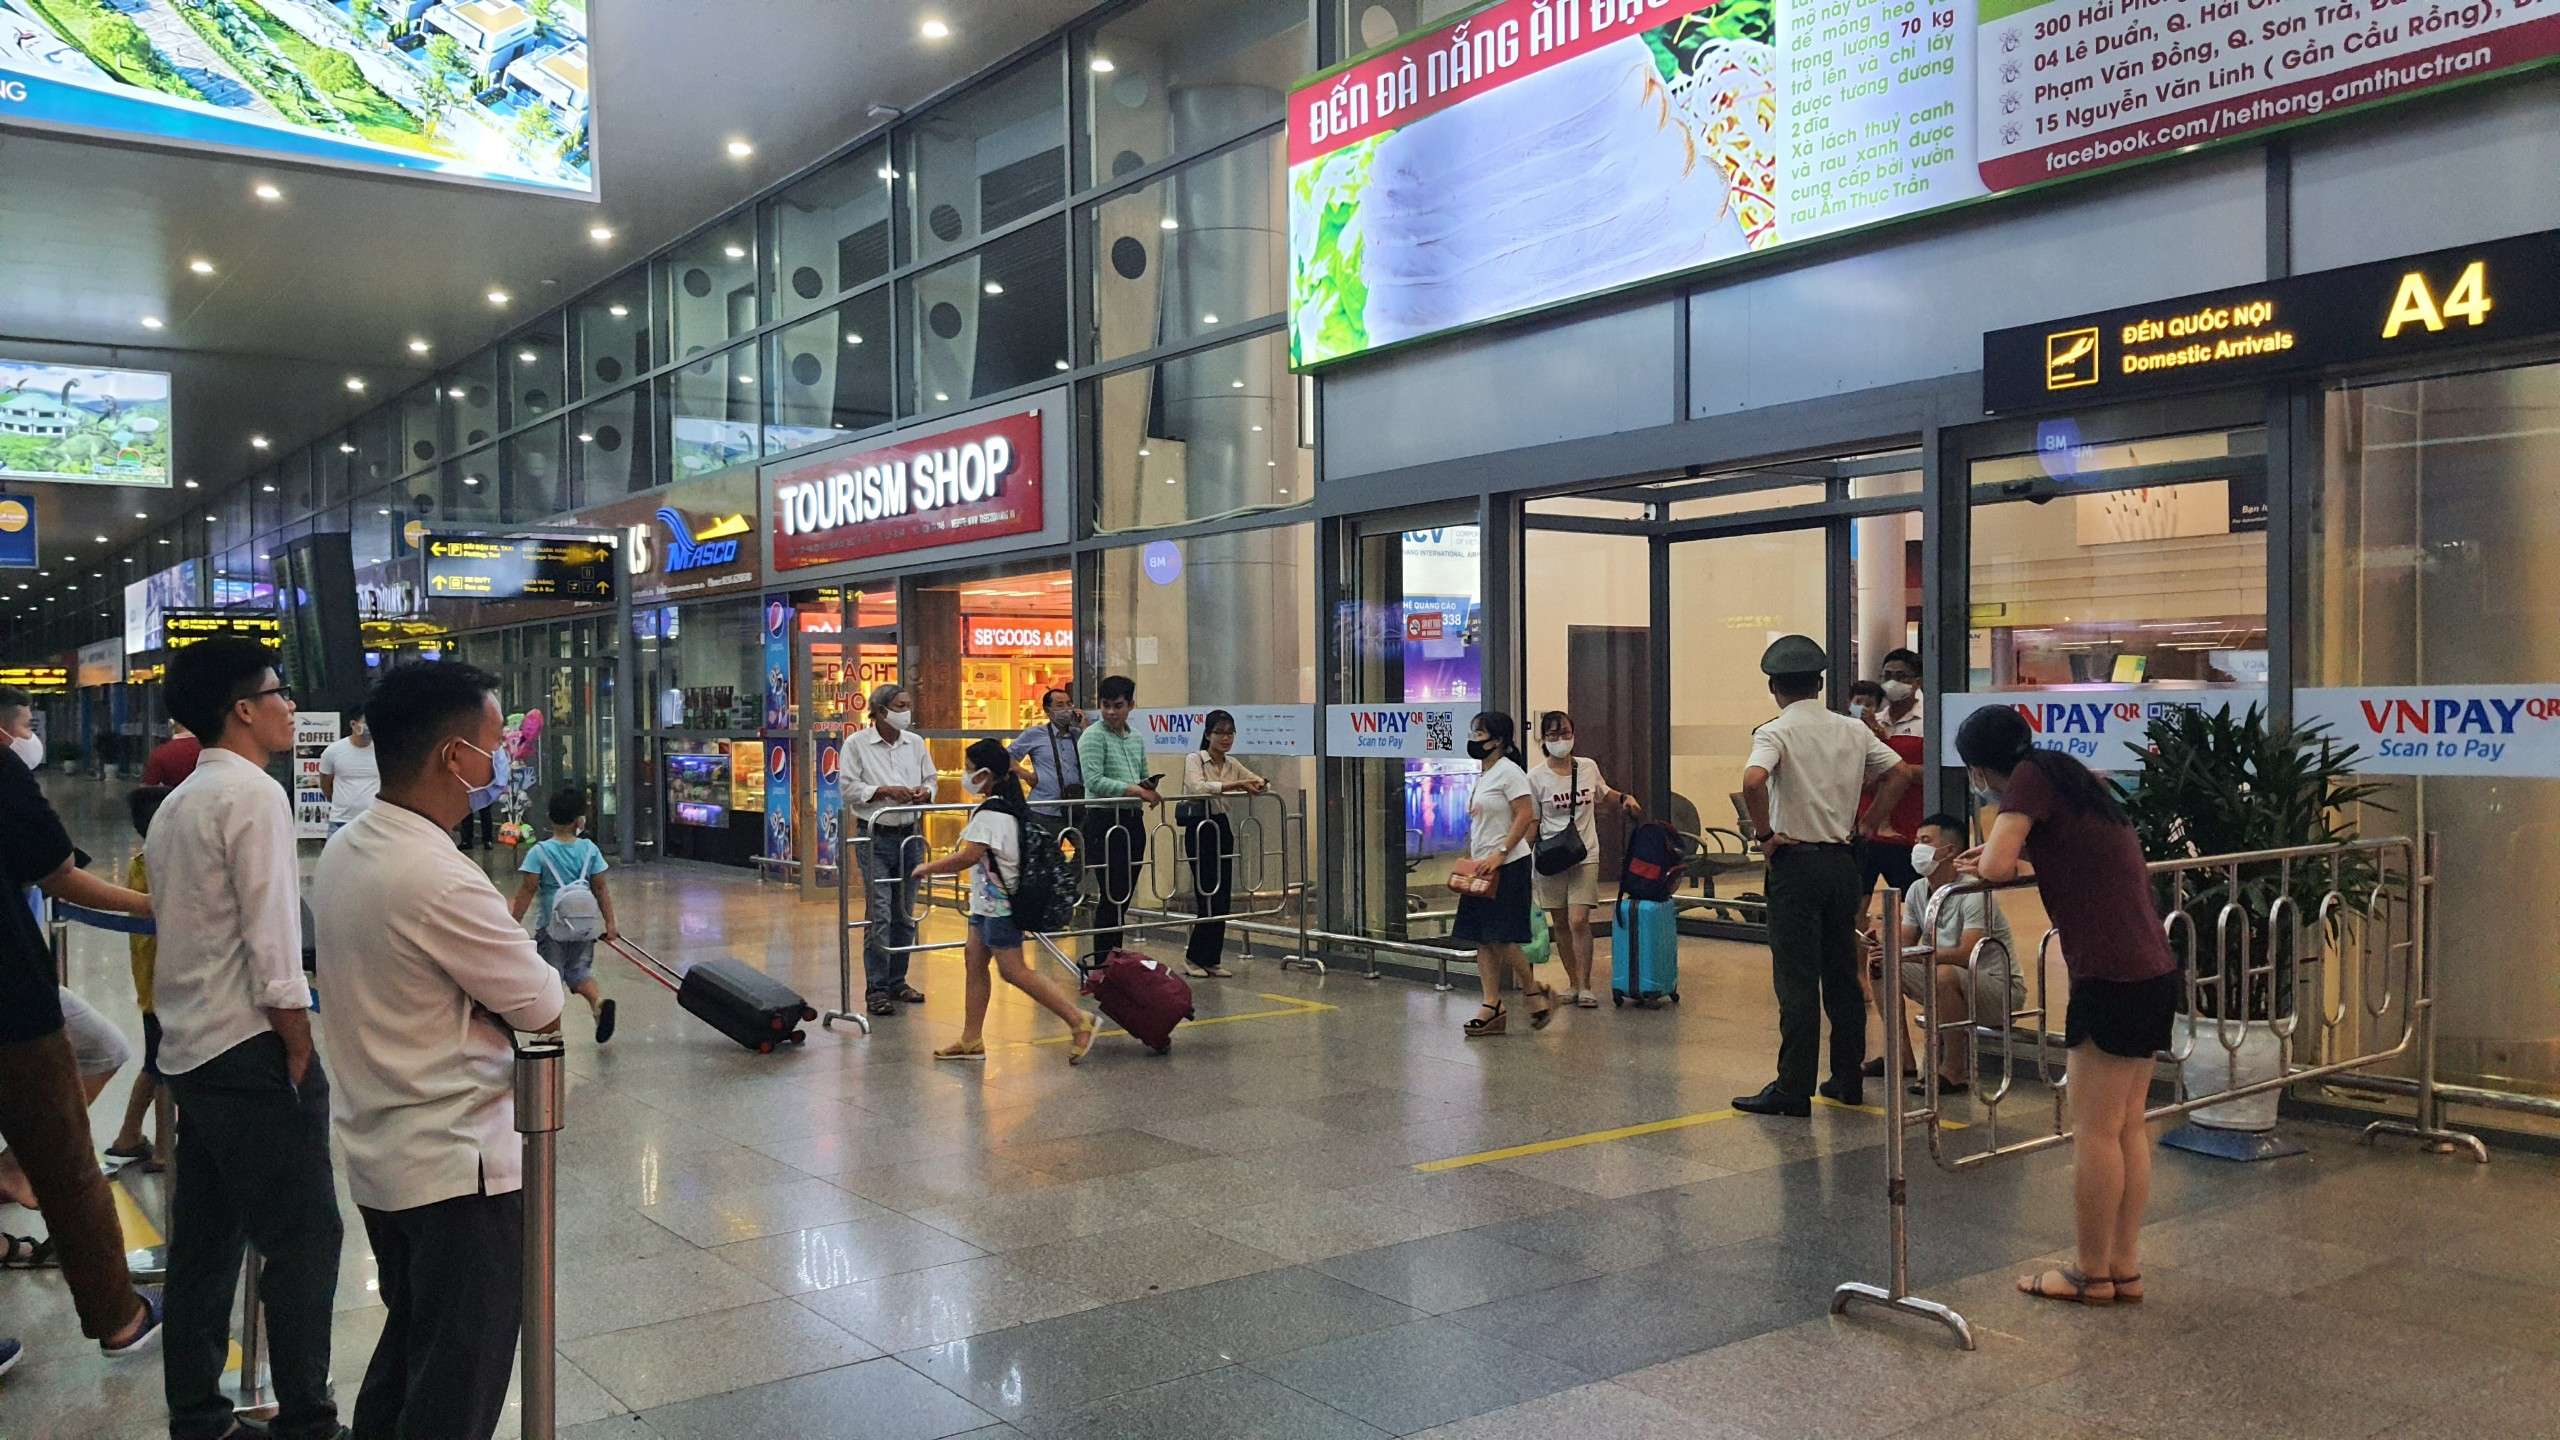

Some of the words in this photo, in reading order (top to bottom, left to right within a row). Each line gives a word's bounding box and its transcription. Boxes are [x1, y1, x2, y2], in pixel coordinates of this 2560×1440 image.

[1791, 50, 1833, 74] trọng
[1843, 32, 1890, 56] lượng
[1901, 18, 1921, 38] 70
[1932, 9, 1954, 29] kg
[1823, 16, 1870, 41] mông
[1882, 1, 1915, 22] heo
[2034, 14, 2071, 41] 300
[2034, 50, 2059, 72] 04
[2066, 40, 2089, 64] Lê
[2095, 19, 2159, 56] Duẩn,
[2166, 13, 2192, 33] Q.
[1823, 67, 1847, 86] lên
[1858, 54, 1879, 74] và
[1890, 40, 1916, 64] chỉ
[1927, 28, 1954, 53] lấy
[2034, 75, 2094, 104] Phạm
[2100, 60, 2144, 85] Văn
[2152, 41, 2219, 71] Đồng,
[2227, 29, 2254, 50] Q.
[2262, 16, 2306, 41] Sơn
[2035, 113, 2059, 135] 15
[2066, 88, 2148, 128] Nguyễn
[2155, 78, 2200, 103] Văn
[2208, 62, 2254, 90] Linh
[2281, 38, 2335, 71] Gần
[2343, 20, 2398, 54] Cầu
[1310, 74, 1369, 145] ĐẾN
[1376, 56, 1418, 119] ĐÀ
[1428, 20, 1519, 98] NẴNG
[1791, 95, 1832, 117] được
[1840, 77, 1889, 102] tương
[1898, 57, 1955, 85] đương
[1791, 122, 1800, 138] 2
[1791, 140, 1813, 160] Xà
[1821, 129, 1857, 151] lách
[1910, 101, 1955, 126] canh
[2046, 46, 2491, 171] facebook.com/hethong.amthuctran
[1791, 161, 1811, 180] và
[1820, 155, 1847, 173] rau
[1856, 138, 1899, 163] xanh
[1909, 125, 1955, 149] được
[1791, 181, 1831, 202] cung
[1838, 165, 1871, 188] cấp
[1876, 156, 1904, 180] bởi
[1911, 146, 1955, 169] vườn
[1790, 203, 1817, 225] rau
[1893, 173, 1930, 198] Trần
[2381, 261, 2494, 339] A4
[2122, 344, 2212, 375] Domestic
[2214, 331, 2294, 361] Arrivals
[778, 461, 908, 536] TOURISM
[911, 435, 1011, 511] SHOP
[664, 539, 739, 573] MASCO
[1420, 550, 1464, 558] INTERNATIONAL
[974, 629, 1041, 647] SB'GOODS
[1044, 630, 1053, 646] &
[1442, 613, 1462, 626] 338
[827, 658, 889, 682] BÁCH
[298, 731, 335, 743] COFFEE
[1154, 734, 1170, 745] Scan
[1169, 735, 1177, 744] to
[1177, 735, 1190, 747] Pay
[1358, 736, 1376, 747] Scan
[1378, 736, 1387, 746] to
[1388, 736, 1404, 750] Pay
[2052, 738, 2064, 751] to
[2068, 737, 2099, 758] Pay
[2379, 738, 2429, 757] Scan
[2436, 739, 2458, 758] to
[2464, 739, 2506, 762] Pay
